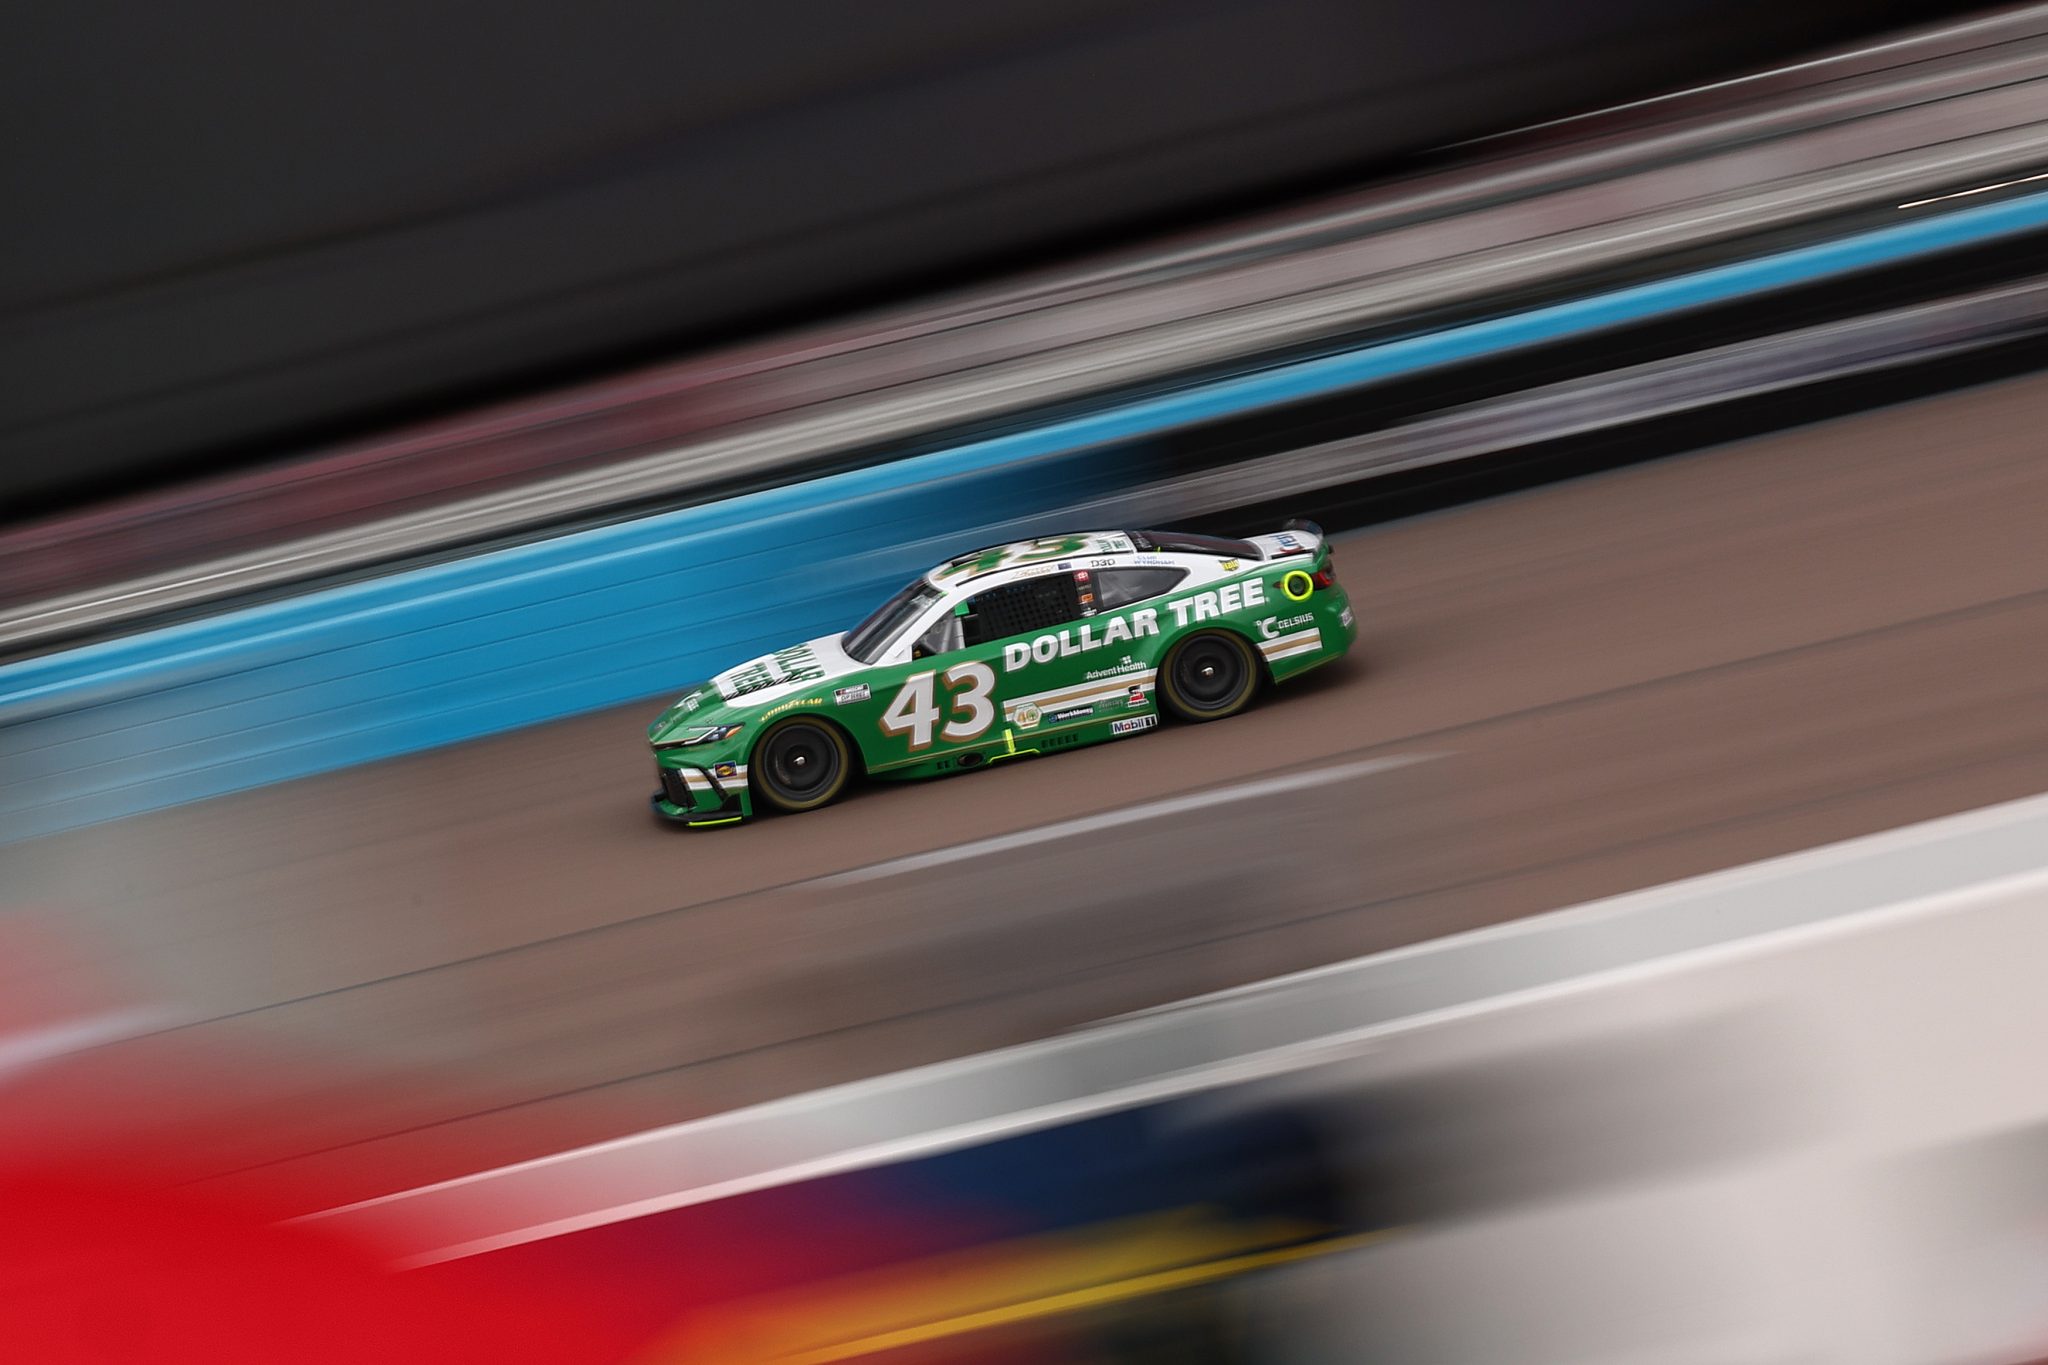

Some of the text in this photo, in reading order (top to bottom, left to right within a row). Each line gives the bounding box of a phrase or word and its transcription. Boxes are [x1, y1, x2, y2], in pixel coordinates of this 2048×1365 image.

[1004, 577, 1266, 673] DOLLAR TREE
[1278, 612, 1314, 629] CELSIUS
[879, 660, 996, 752] 43
[1114, 719, 1145, 733] Mobil
